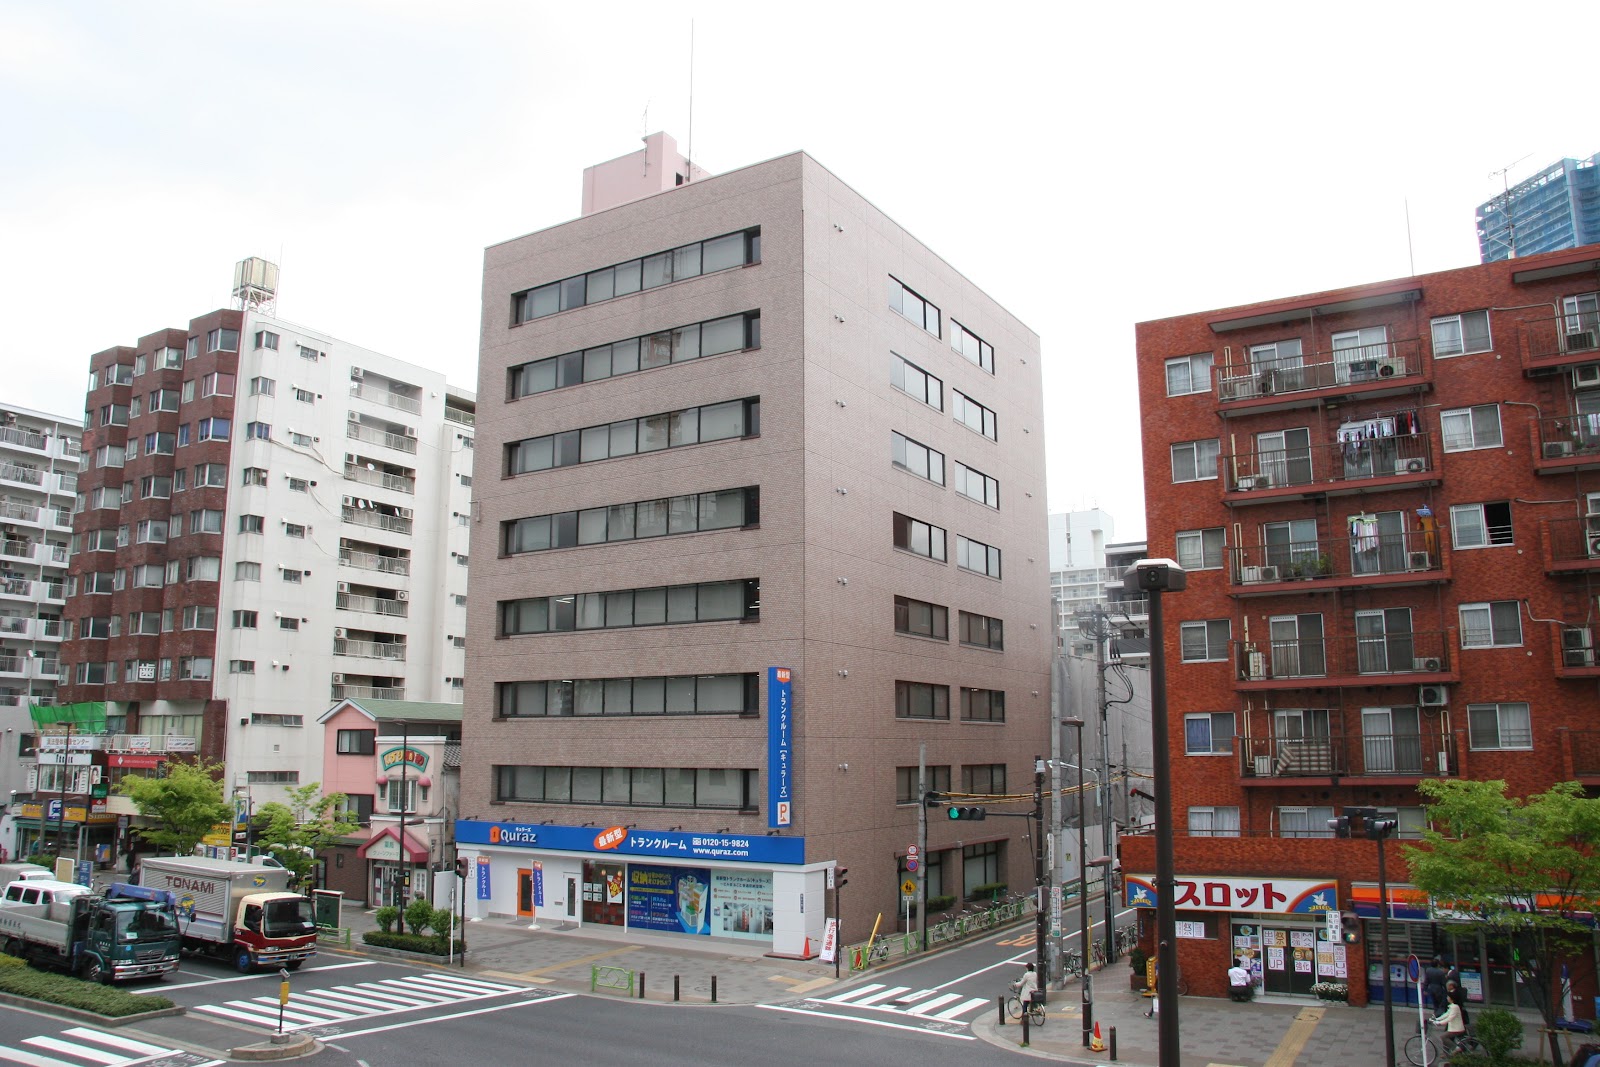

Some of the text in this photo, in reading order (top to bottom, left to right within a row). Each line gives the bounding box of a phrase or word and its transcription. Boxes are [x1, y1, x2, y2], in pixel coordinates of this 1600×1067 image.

[138, 663, 156, 679] 歯
[500, 829, 537, 843] Quraz
[598, 828, 623, 847] 最新型
[630, 836, 687, 850] トランクルーム
[702, 838, 749, 848] 0120-15-9824
[693, 847, 749, 857] www.quraz.com
[165, 875, 214, 894] TONAMI
[1174, 882, 1287, 910] スロット
[1275, 931, 1285, 945] 祭
[1269, 959, 1283, 969] UP
[1295, 961, 1310, 971] 強化
